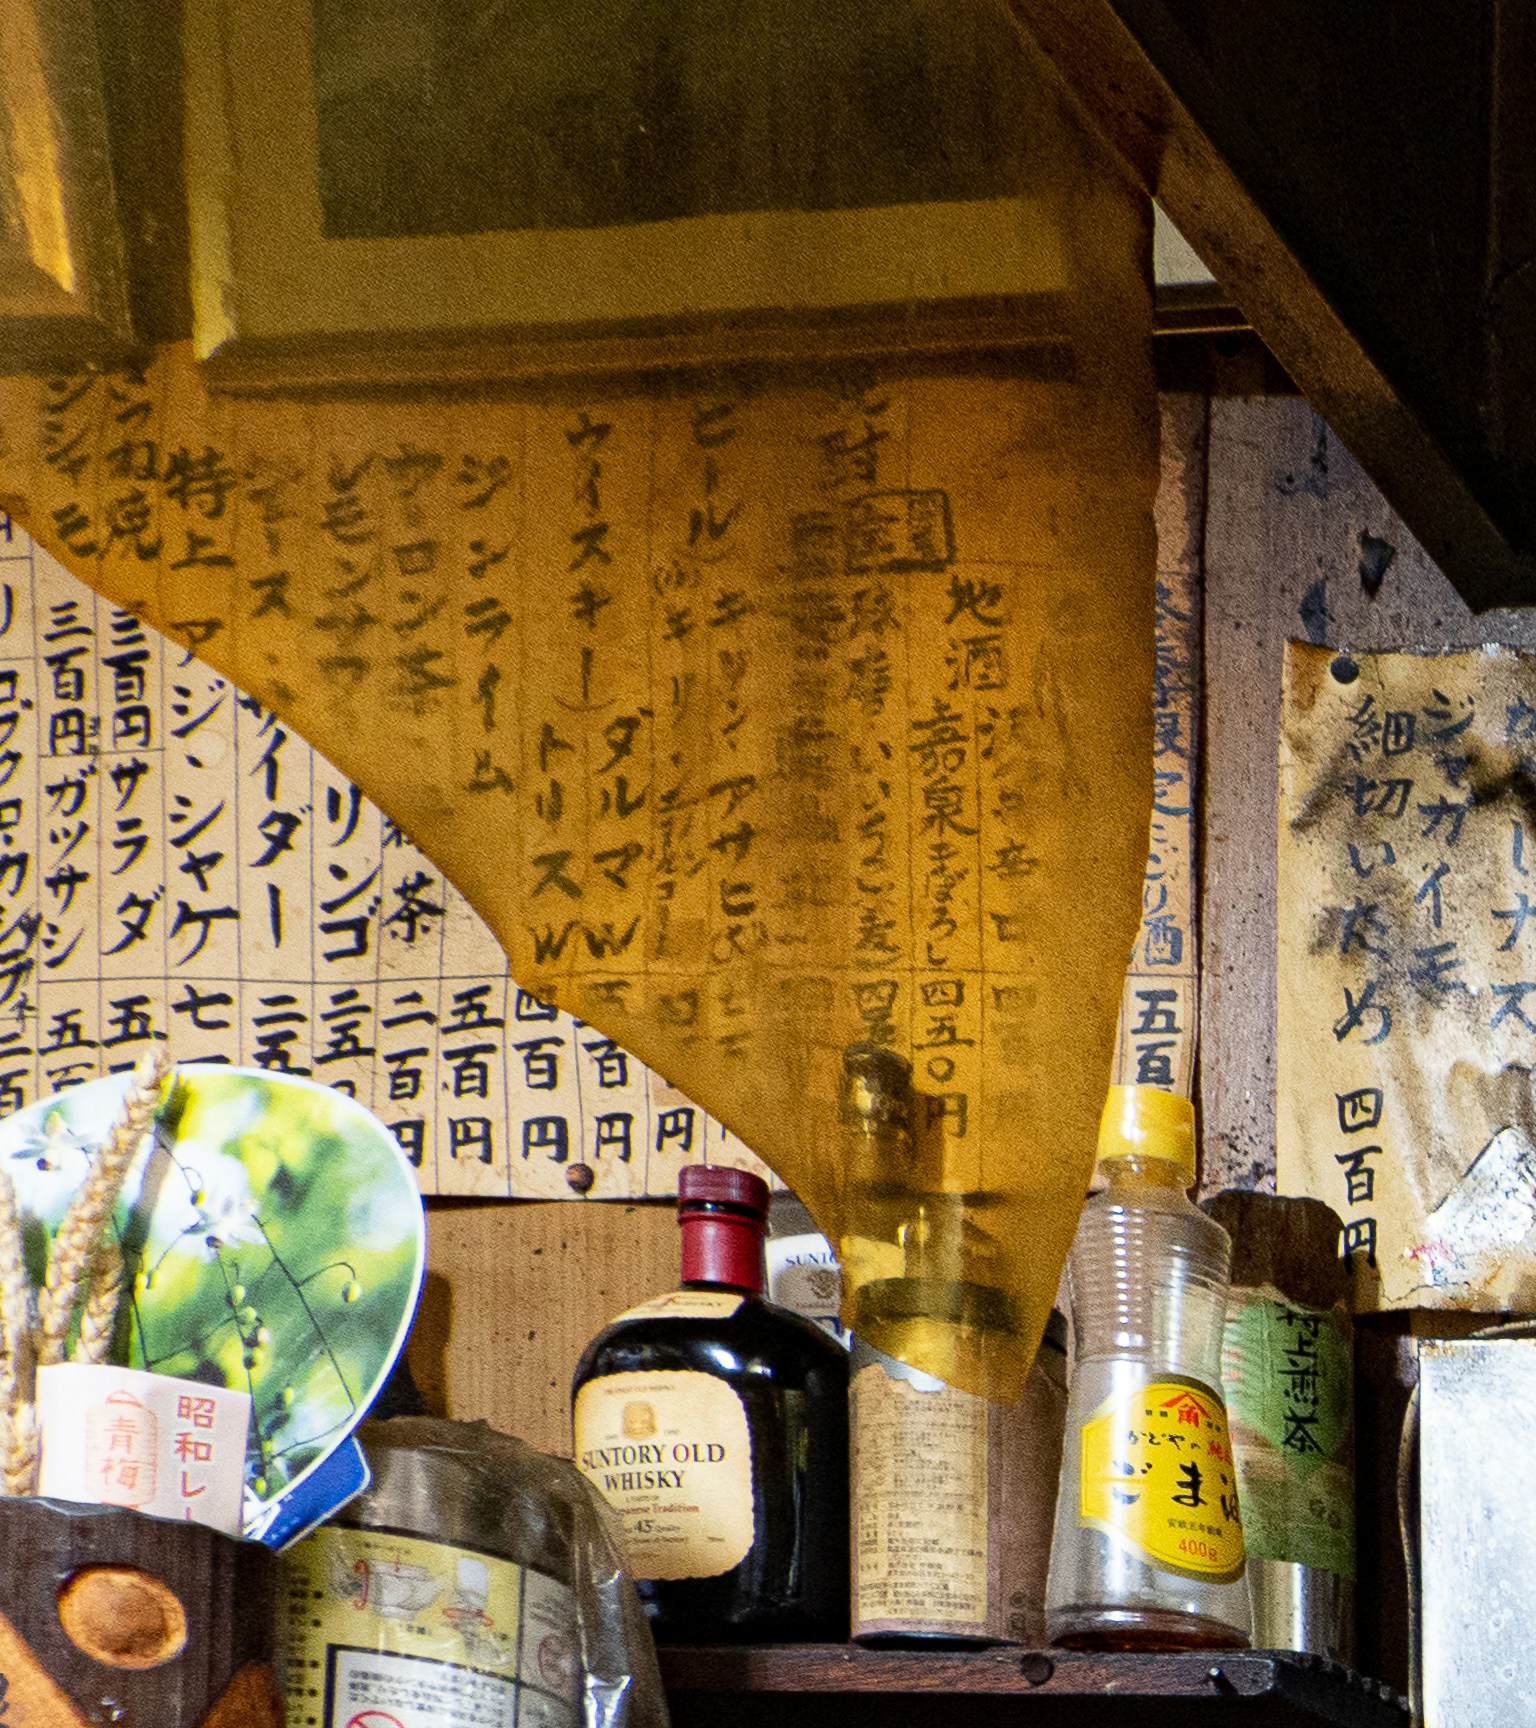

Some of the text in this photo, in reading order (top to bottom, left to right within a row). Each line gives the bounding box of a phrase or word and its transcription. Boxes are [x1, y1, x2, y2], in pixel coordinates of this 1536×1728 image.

[440, 985, 500, 1164] 五百円
[581, 1442, 728, 1471] SUNTORY OLD
[603, 1470, 687, 1493] WHISKY
